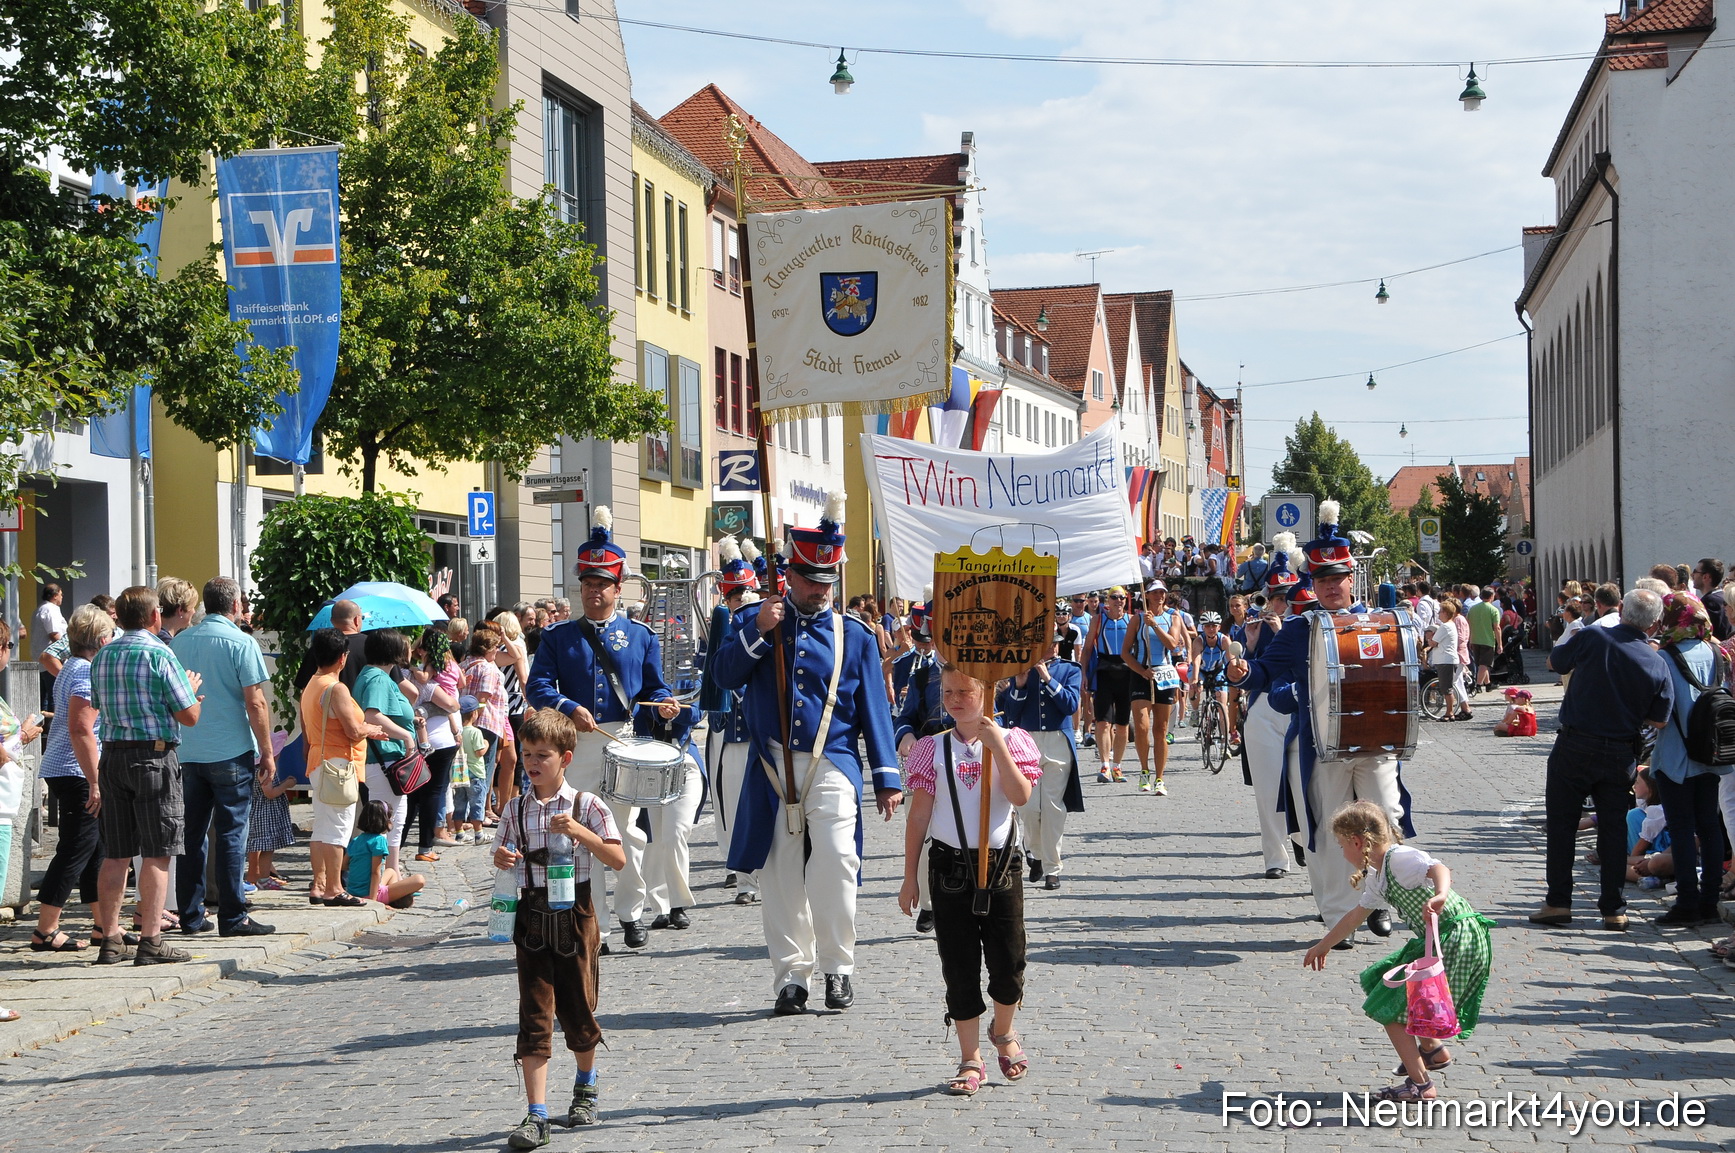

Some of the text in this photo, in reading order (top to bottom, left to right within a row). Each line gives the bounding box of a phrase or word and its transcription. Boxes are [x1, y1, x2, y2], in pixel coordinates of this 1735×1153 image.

[235, 301, 310, 314] Raiffeisenbank
[912, 294, 929, 307] 1982
[326, 313, 338, 323] eG
[802, 348, 902, 375] Stadt Hemau
[526, 475, 582, 485] Brunnwirtsgasse
[874, 454, 980, 508] TWin
[988, 437, 1117, 510] Neumarkt
[1227, 476, 1239, 487] H
[473, 497, 489, 531] P
[724, 511, 739, 529] G2
[1425, 523, 1434, 533] H
[957, 557, 1036, 574] Tangrintler
[944, 573, 1047, 603] Spielmannszug
[957, 648, 1032, 664] HEMAU
